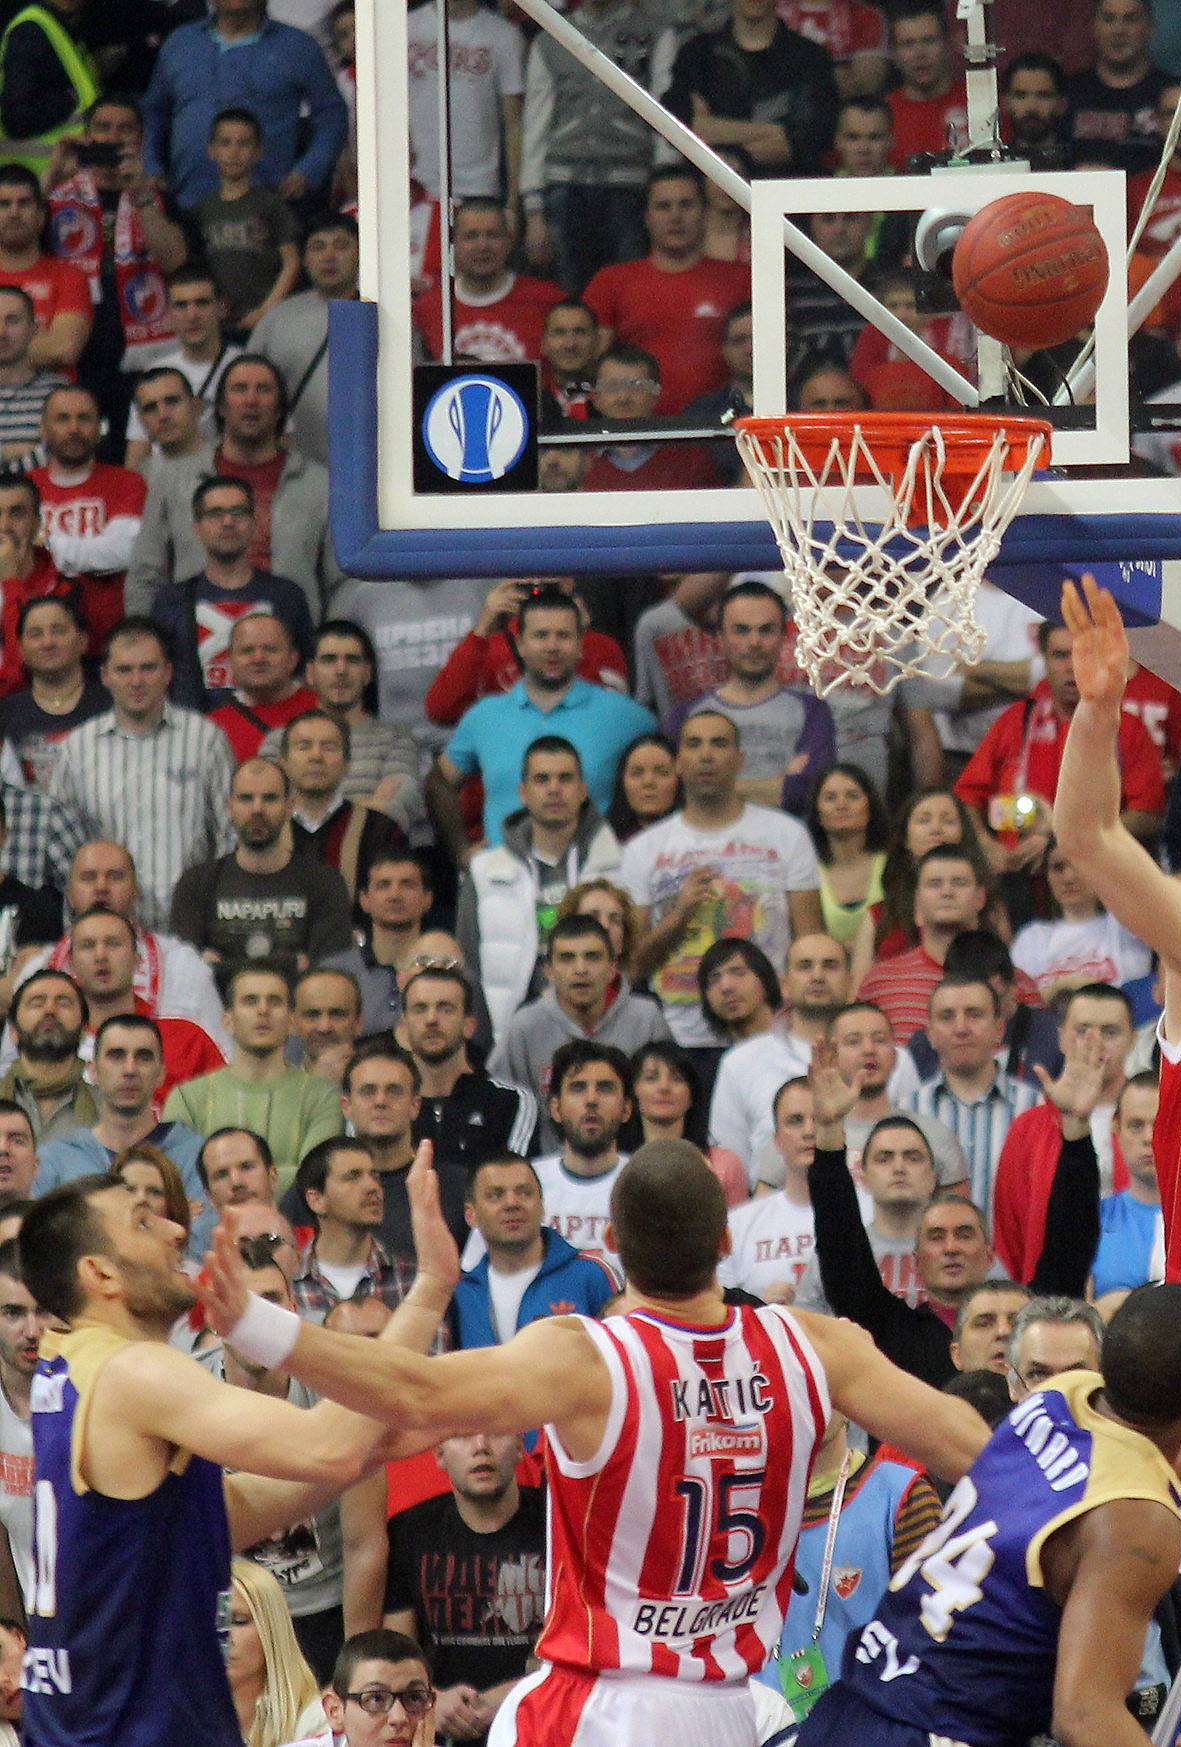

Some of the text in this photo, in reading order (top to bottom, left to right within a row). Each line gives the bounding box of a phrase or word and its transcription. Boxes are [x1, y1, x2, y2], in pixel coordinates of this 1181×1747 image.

[755, 1234, 814, 1264] ПАР
[671, 1361, 774, 1422] KATIĆ
[690, 1431, 763, 1457] Frikom
[668, 1467, 770, 1598] 15
[888, 1474, 1000, 1643] 24
[633, 1592, 766, 1638] BELGRADE
